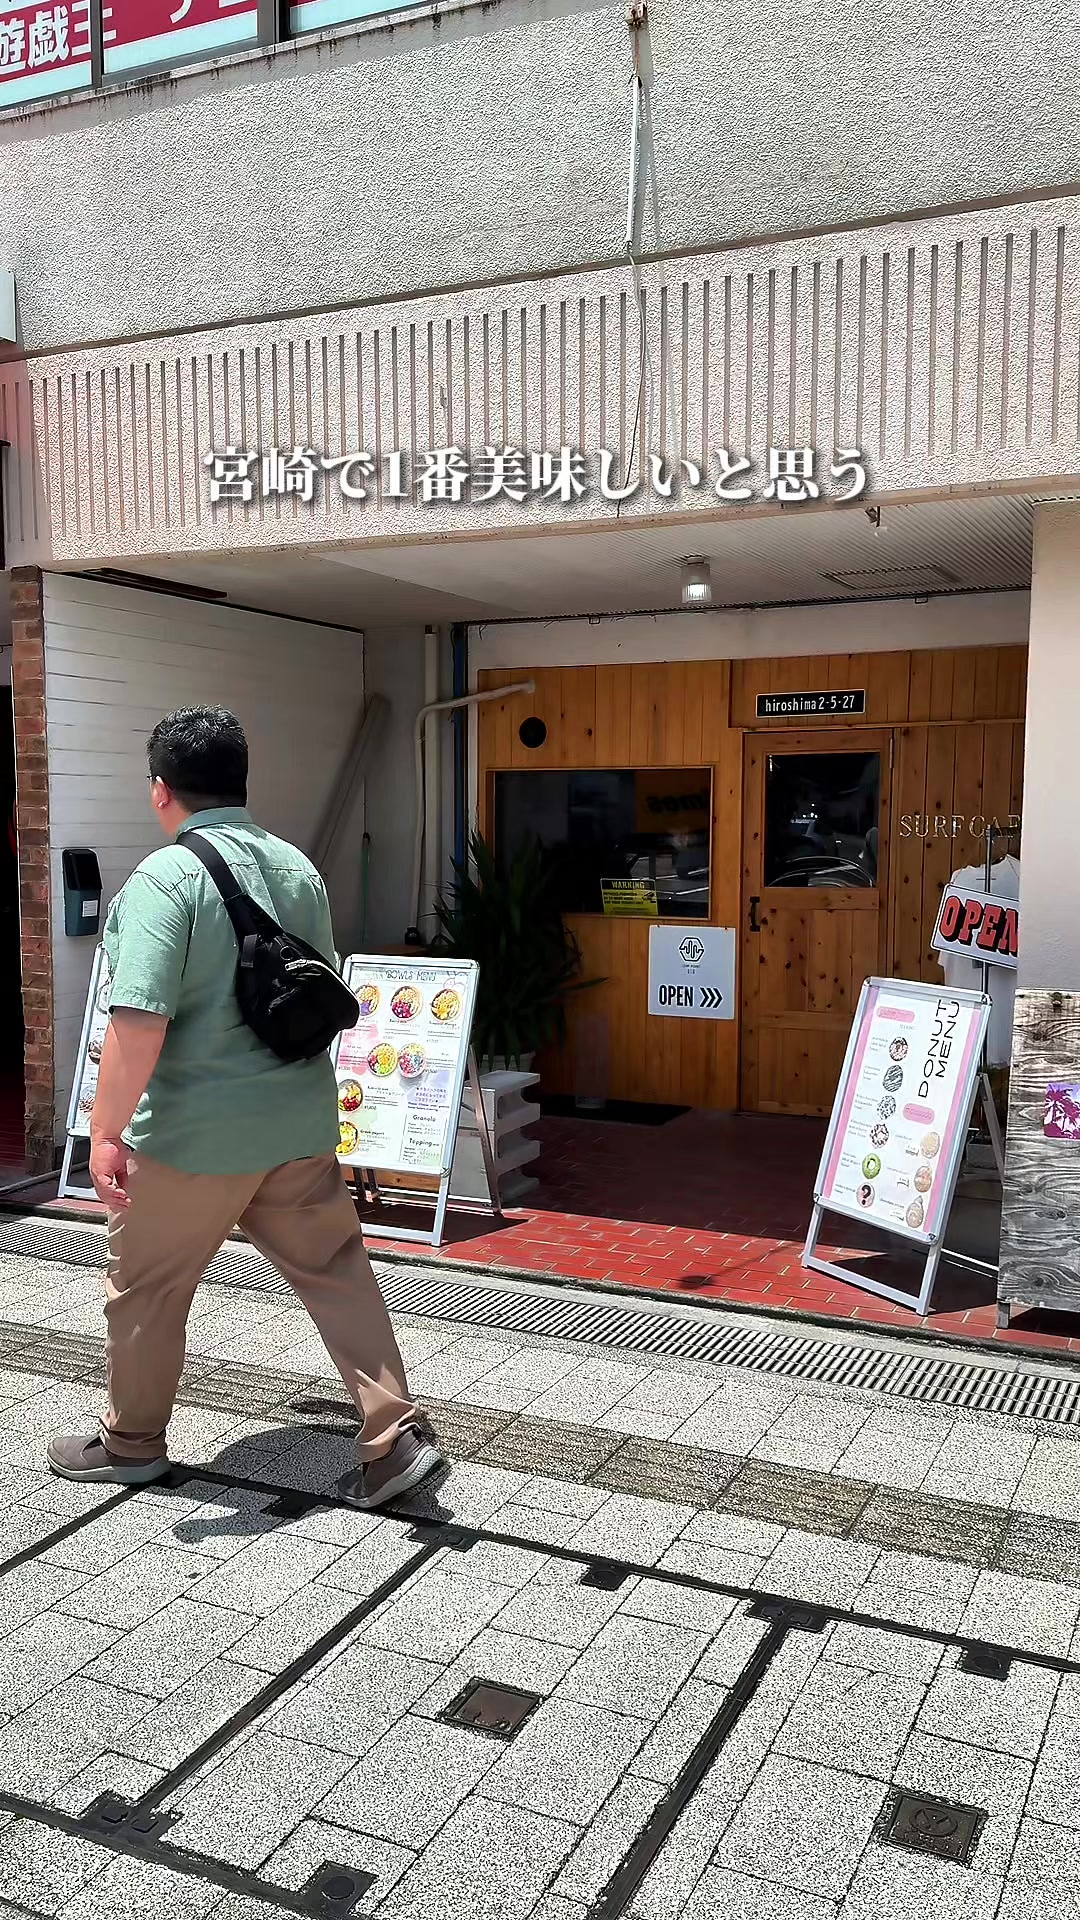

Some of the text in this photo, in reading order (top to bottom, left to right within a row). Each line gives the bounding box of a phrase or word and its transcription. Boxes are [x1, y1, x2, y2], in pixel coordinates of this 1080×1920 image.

[765, 697, 817, 712] hiroshima
[659, 984, 693, 1007] OPEN
[918, 999, 946, 1098] DONUT
[935, 1001, 960, 1078] MENU
